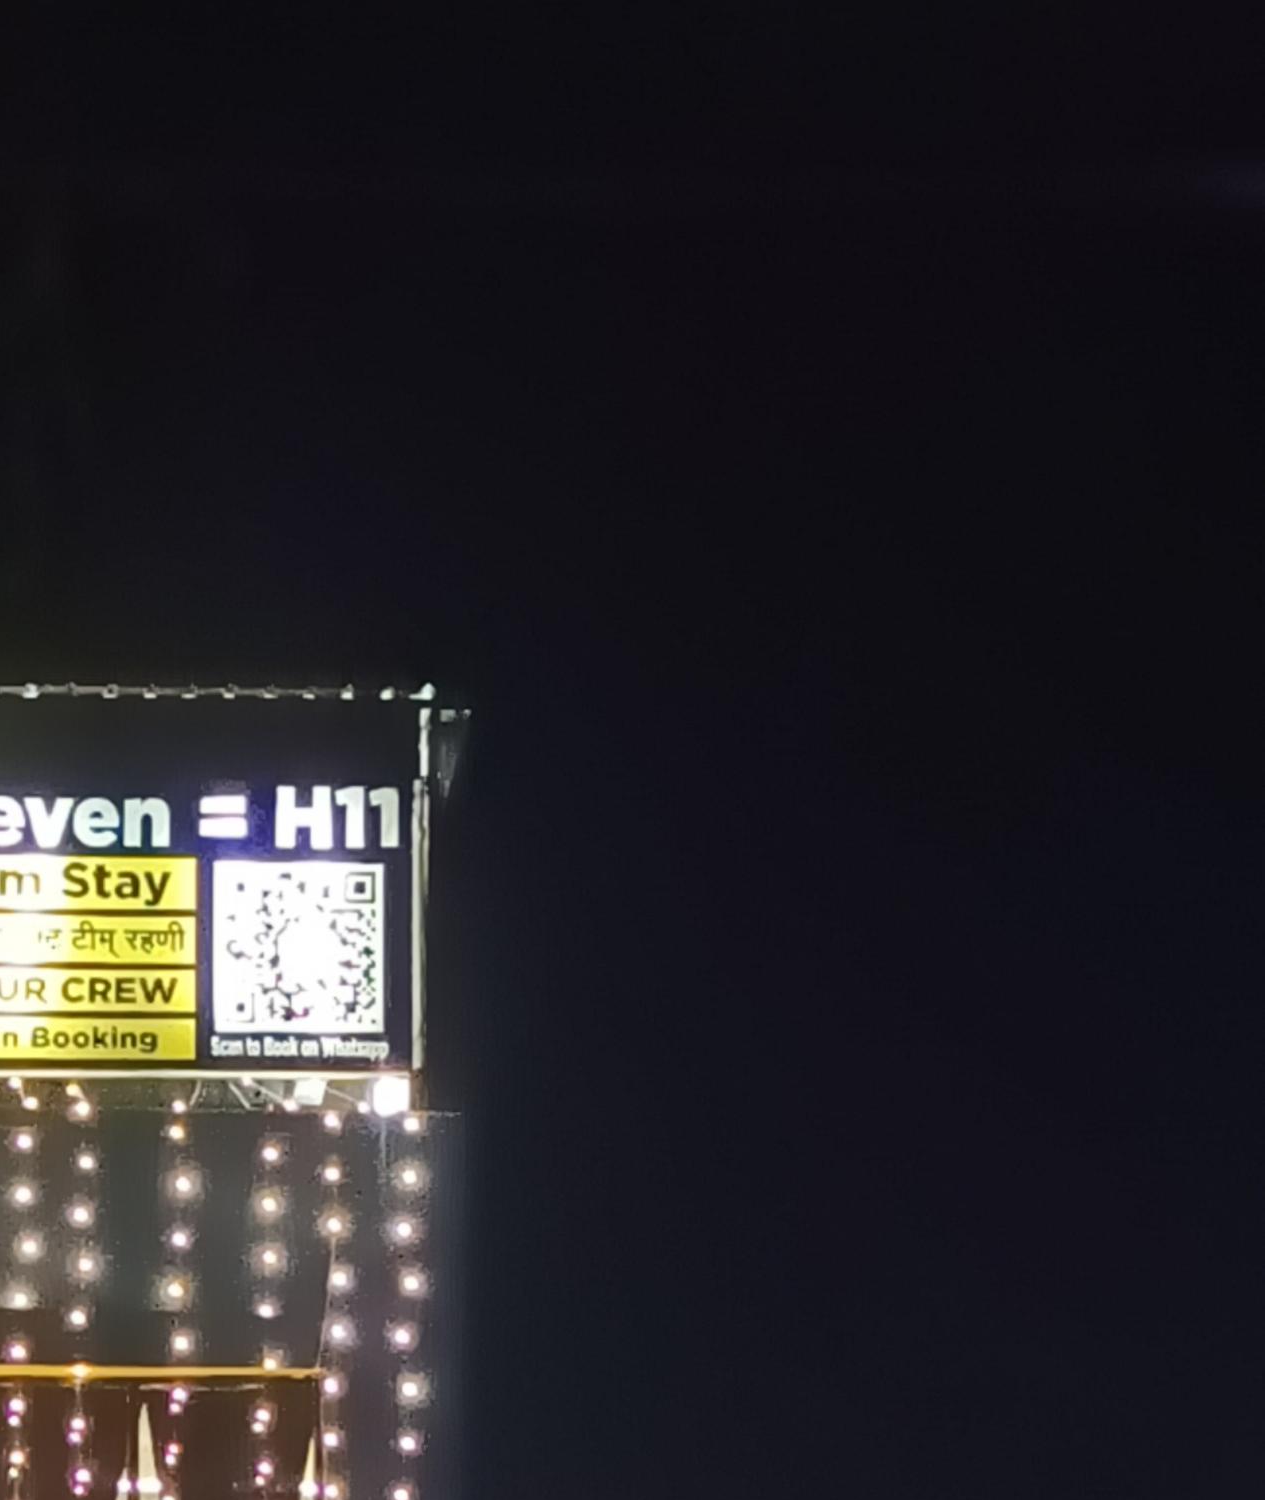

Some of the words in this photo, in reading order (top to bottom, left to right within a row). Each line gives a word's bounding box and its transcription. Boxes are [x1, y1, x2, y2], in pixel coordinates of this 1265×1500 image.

[274, 785, 400, 850] H11
[62, 862, 172, 906] Stay
[61, 977, 179, 1004] CREW
[31, 1026, 158, 1053] Booking
